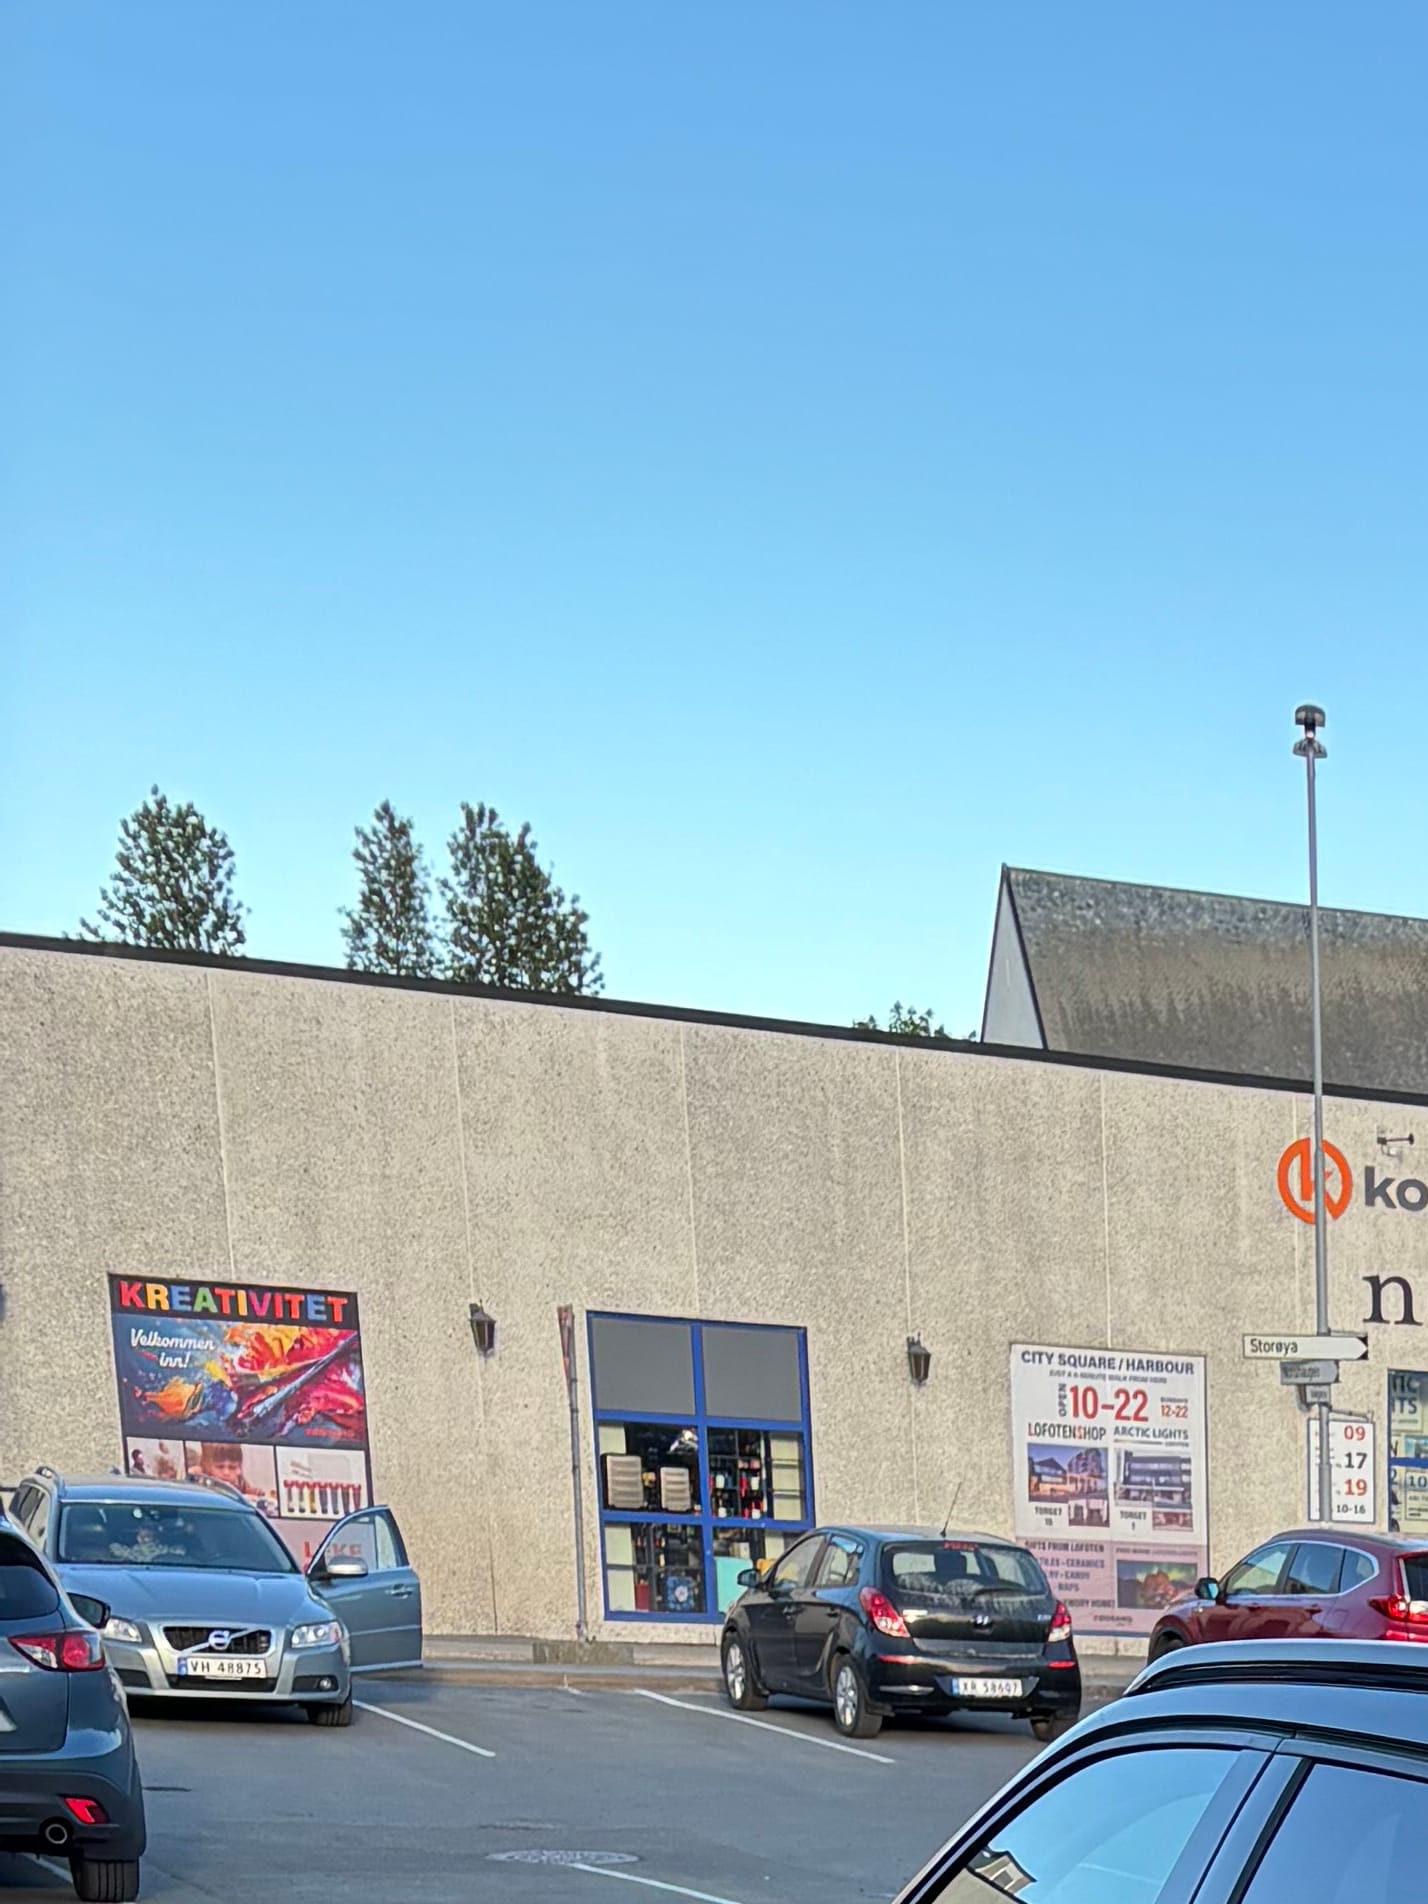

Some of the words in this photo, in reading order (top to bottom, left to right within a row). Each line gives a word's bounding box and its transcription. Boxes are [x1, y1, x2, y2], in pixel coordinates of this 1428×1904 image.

[119, 1280, 348, 1323] KREATIVITET
[130, 1328, 214, 1351] Velkommen
[1250, 1338, 1298, 1356] Storøya
[159, 1351, 190, 1368] inn!
[1021, 1350, 1054, 1365] CITY
[1058, 1353, 1115, 1370] SQUARE
[1126, 1358, 1195, 1375] HARBOUR
[1058, 1383, 1067, 1417] OPEN
[1113, 1426, 1151, 1438] ARCTIC
[1152, 1429, 1189, 1440] LIGHTS
[1344, 1425, 1366, 1441] 09
[1344, 1452, 1367, 1469] 17
[1344, 1479, 1367, 1496] 19
